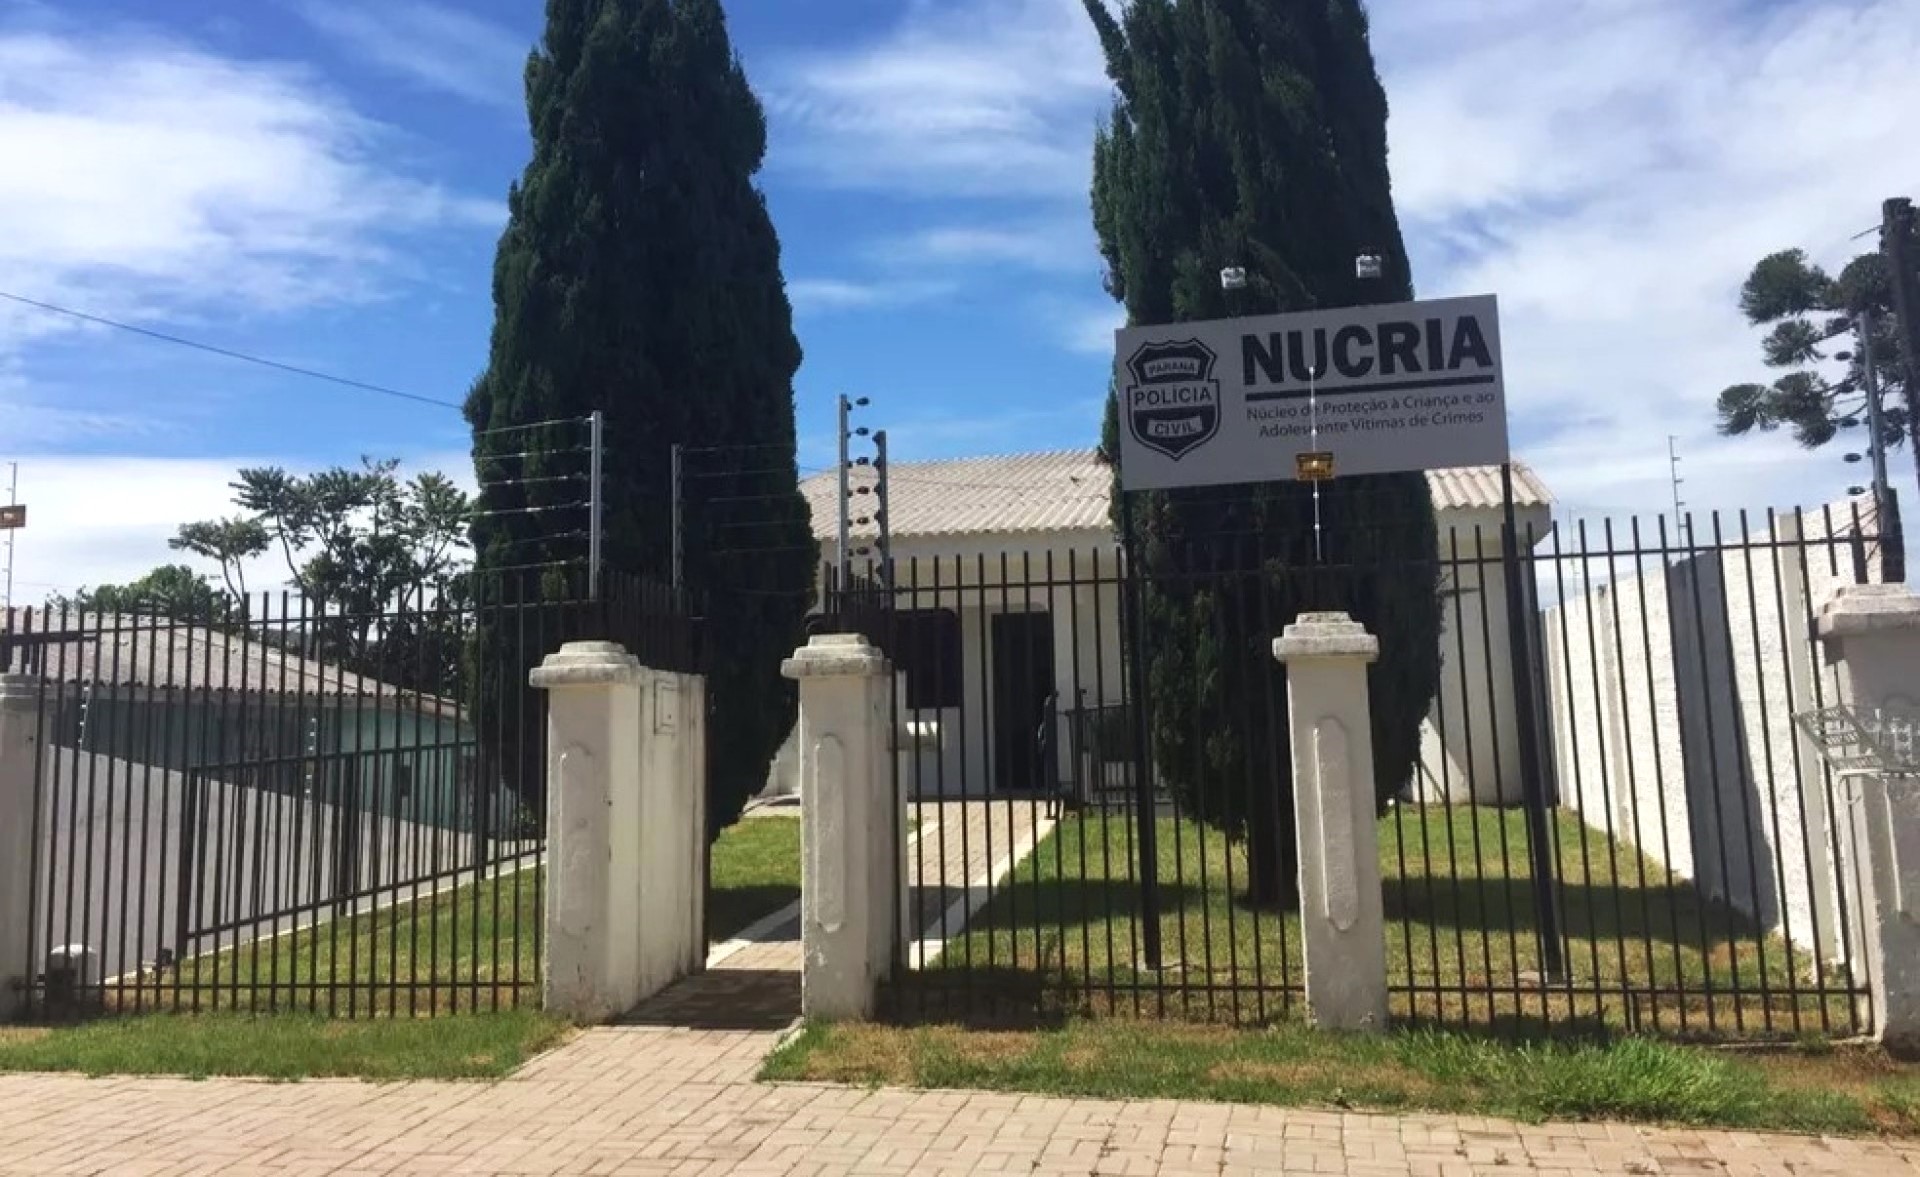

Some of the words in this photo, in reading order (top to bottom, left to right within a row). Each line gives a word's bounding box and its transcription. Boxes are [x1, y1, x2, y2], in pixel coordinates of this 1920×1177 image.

[1241, 315, 1493, 386] NUCRIA
[1135, 385, 1213, 406] POLÍCIA
[1246, 405, 1298, 419] Núcleo
[1323, 399, 1388, 414] Proteção
[1403, 395, 1458, 408] Criança
[1462, 394, 1472, 404] e
[1476, 392, 1496, 404] ao
[1154, 421, 1197, 435] CIVIL
[1409, 414, 1428, 427] de
[1431, 411, 1483, 425] Crimes
